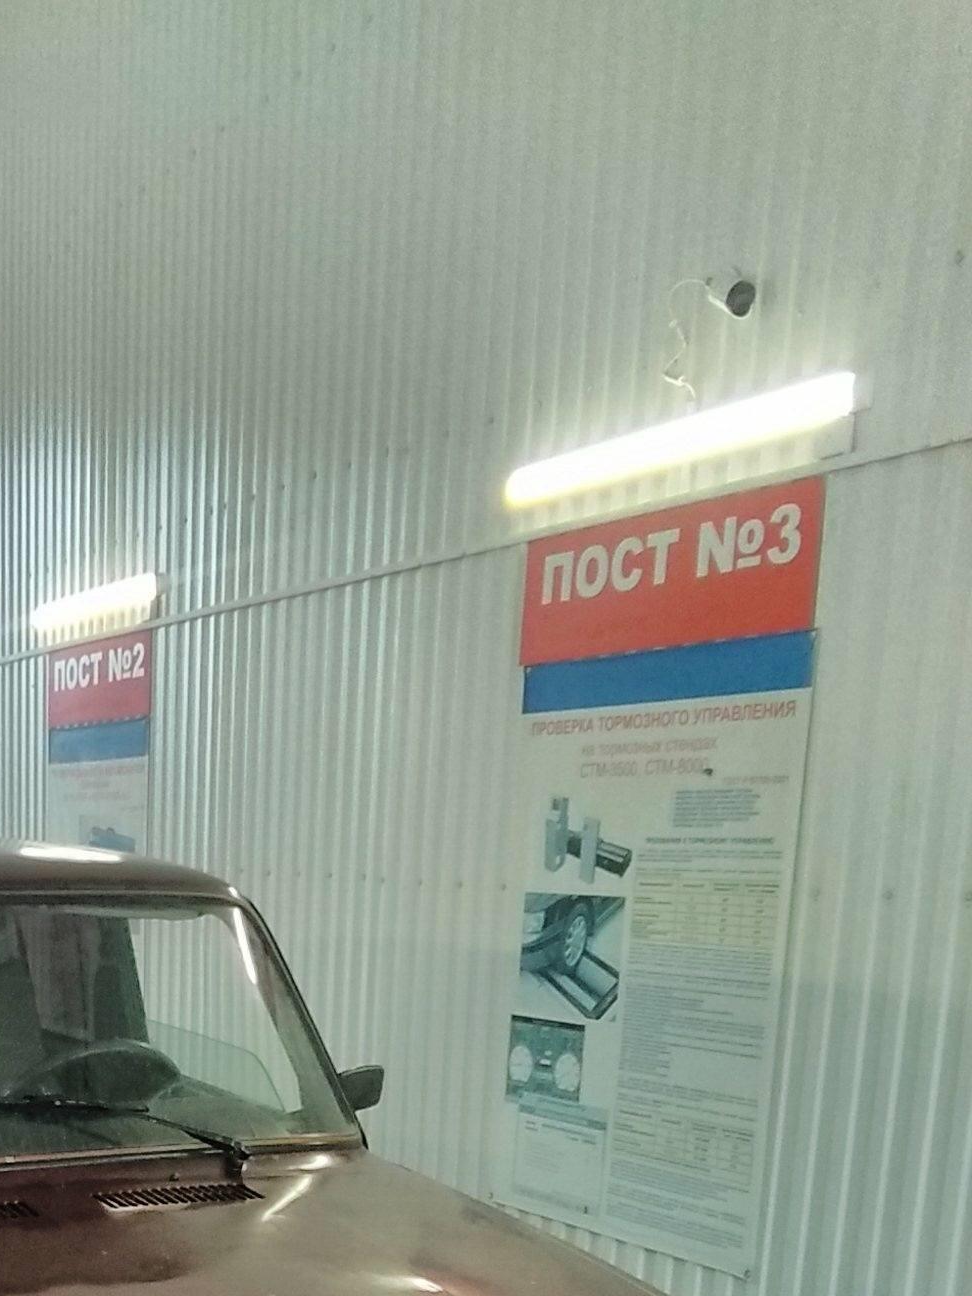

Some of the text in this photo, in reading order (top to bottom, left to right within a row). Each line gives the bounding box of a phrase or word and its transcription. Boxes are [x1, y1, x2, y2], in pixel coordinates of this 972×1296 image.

[542, 503, 802, 605] ПОСТ №3
[54, 642, 145, 691] ПОСТ №2
[531, 699, 797, 737] ПРОВЕРКА ТОРМОЗНОГО УПРАВЛЕНИЯ
